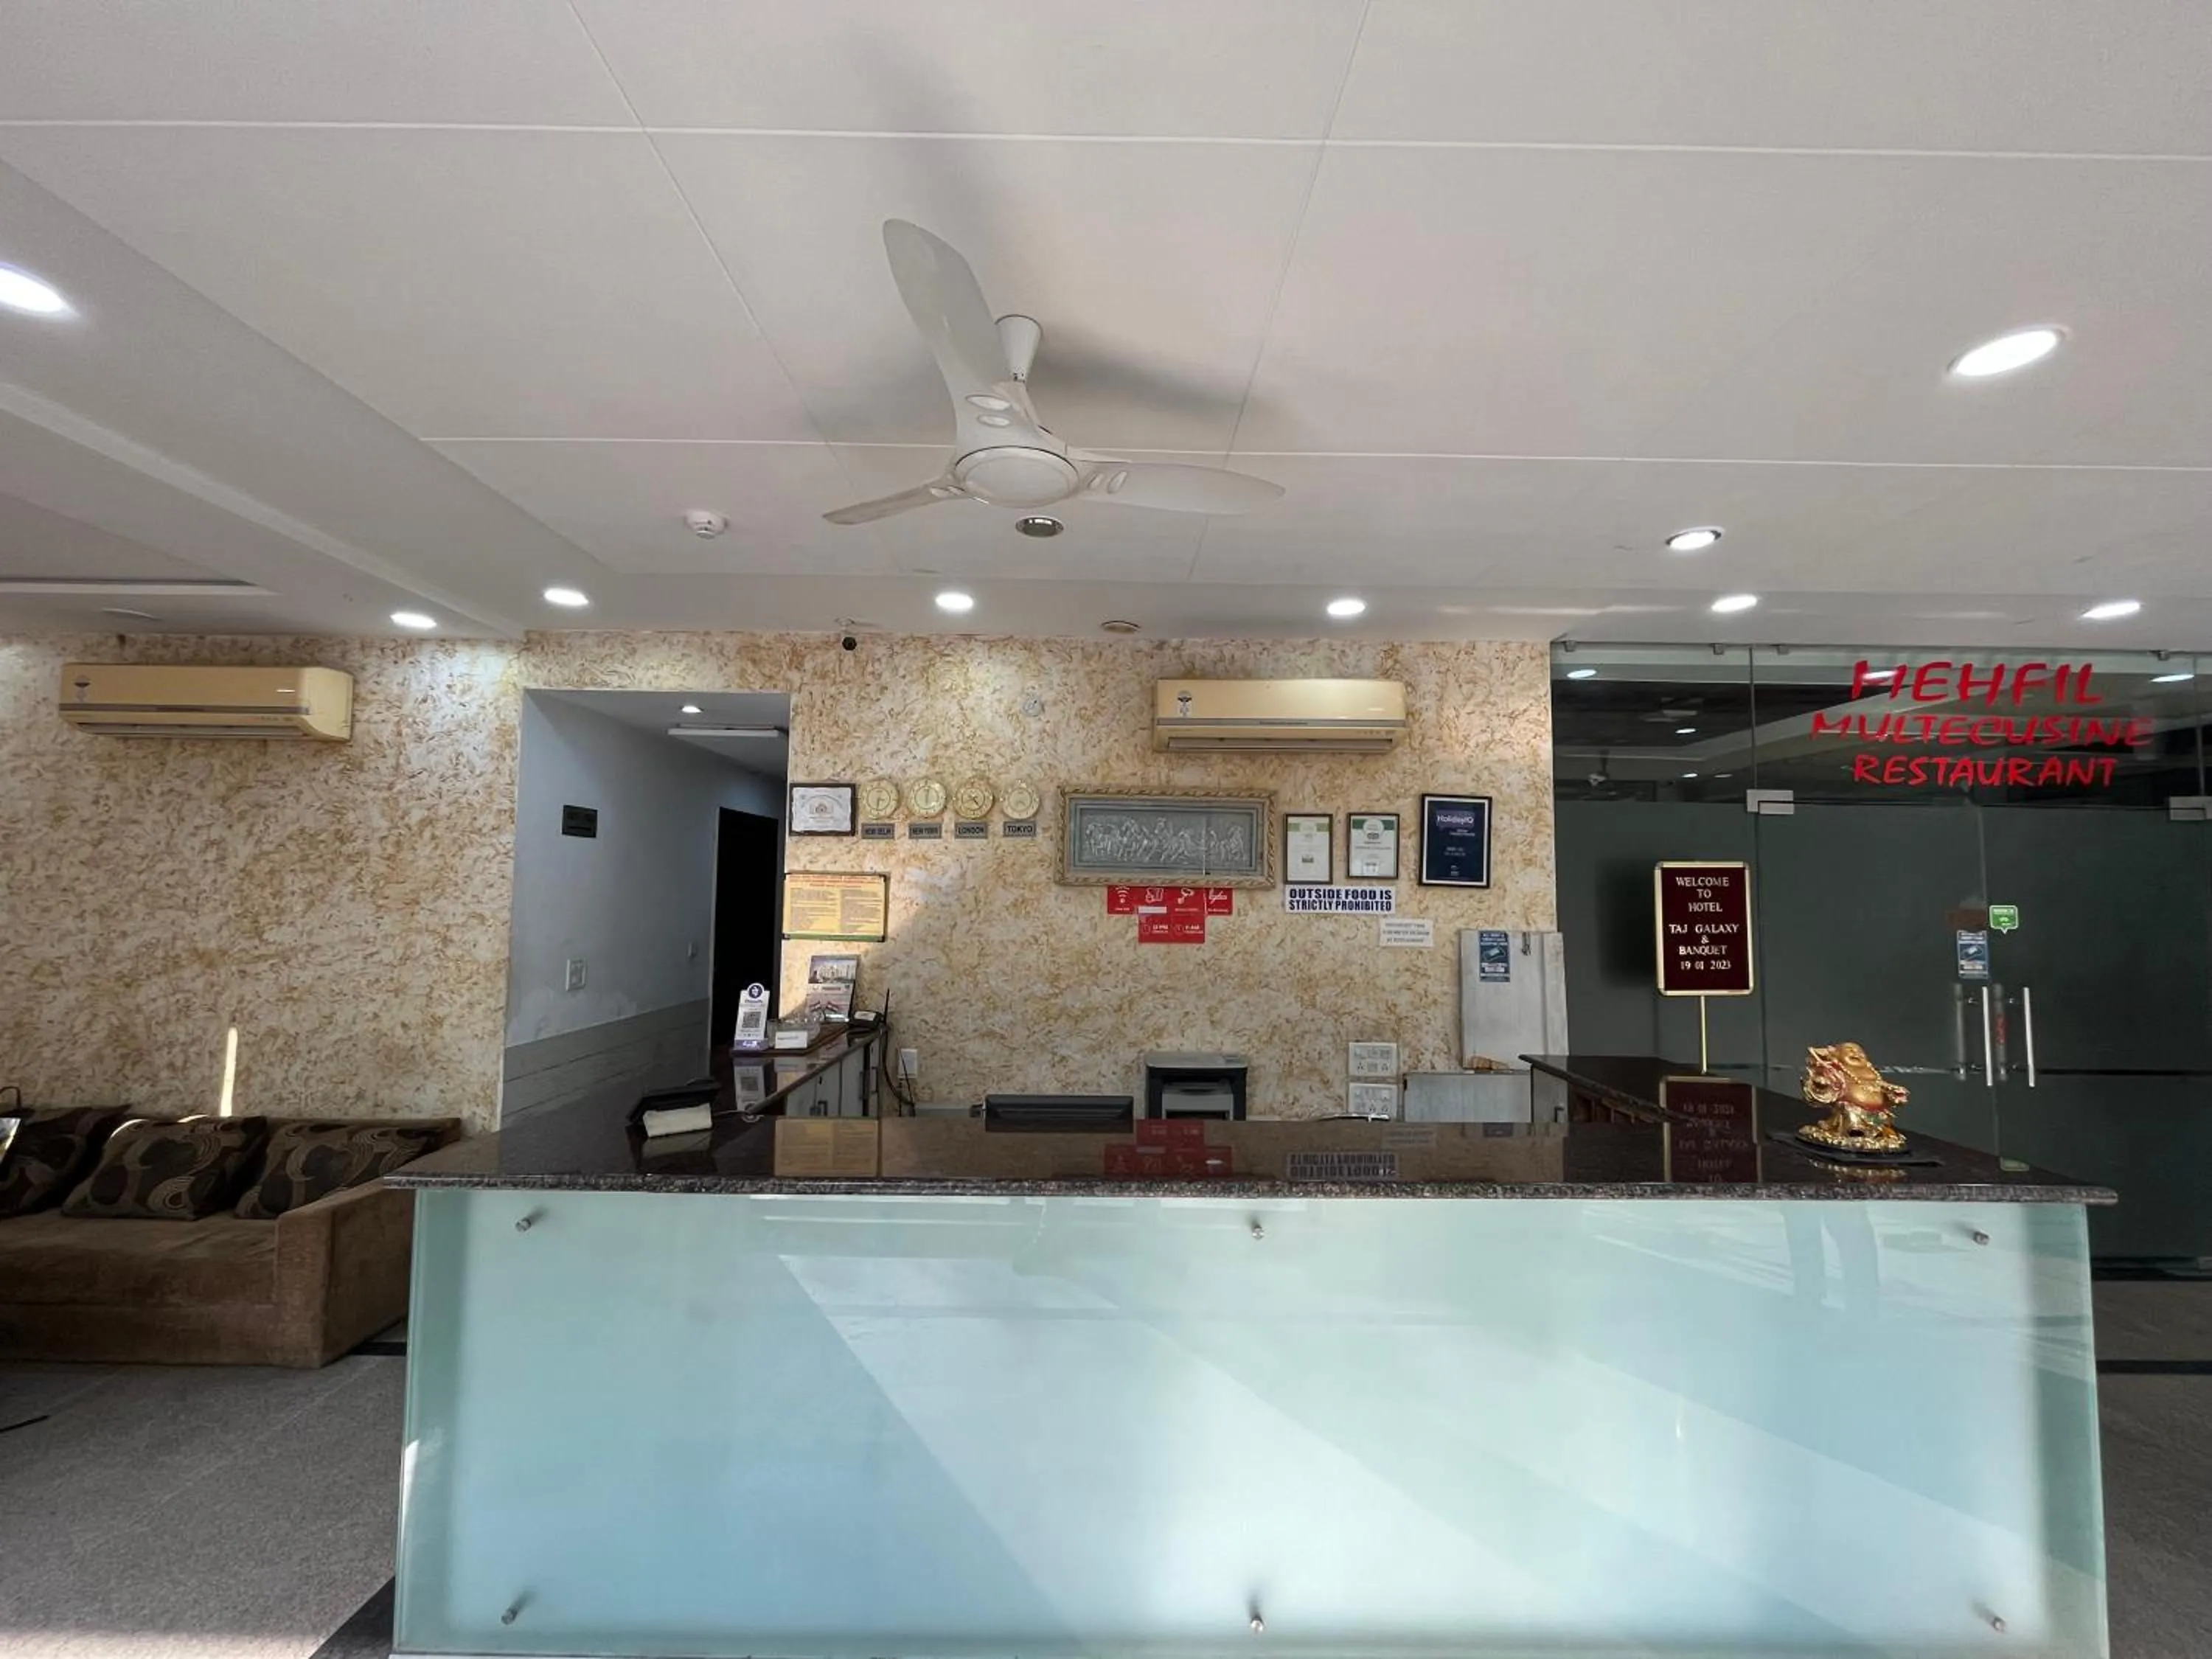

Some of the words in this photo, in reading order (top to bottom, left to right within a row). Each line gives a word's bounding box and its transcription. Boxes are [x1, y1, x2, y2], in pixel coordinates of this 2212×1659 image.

[1811, 712, 2154, 747] MULTECUSINE
[1853, 754, 2118, 787] RESTAURANT
[958, 826, 984, 835] LONDON
[1007, 825, 1033, 833] TOKYO
[1675, 877, 1729, 887] WELCOME
[1290, 888, 1342, 900] OUTSIDE
[1344, 889, 1377, 900] FOOD
[1380, 890, 1392, 900] IS
[1696, 888, 1712, 898] TO
[1289, 900, 1333, 911] STRICTLY
[1335, 900, 1392, 911] PROHIBITED
[1688, 902, 1723, 912] HOTEL
[1669, 924, 1688, 933] TAJ
[1695, 924, 1739, 933] GALAXY
[1701, 935, 1709, 944] &
[1679, 945, 1728, 956] BANQUET
[1680, 961, 1691, 970] 19
[1710, 960, 1731, 970] 2023
